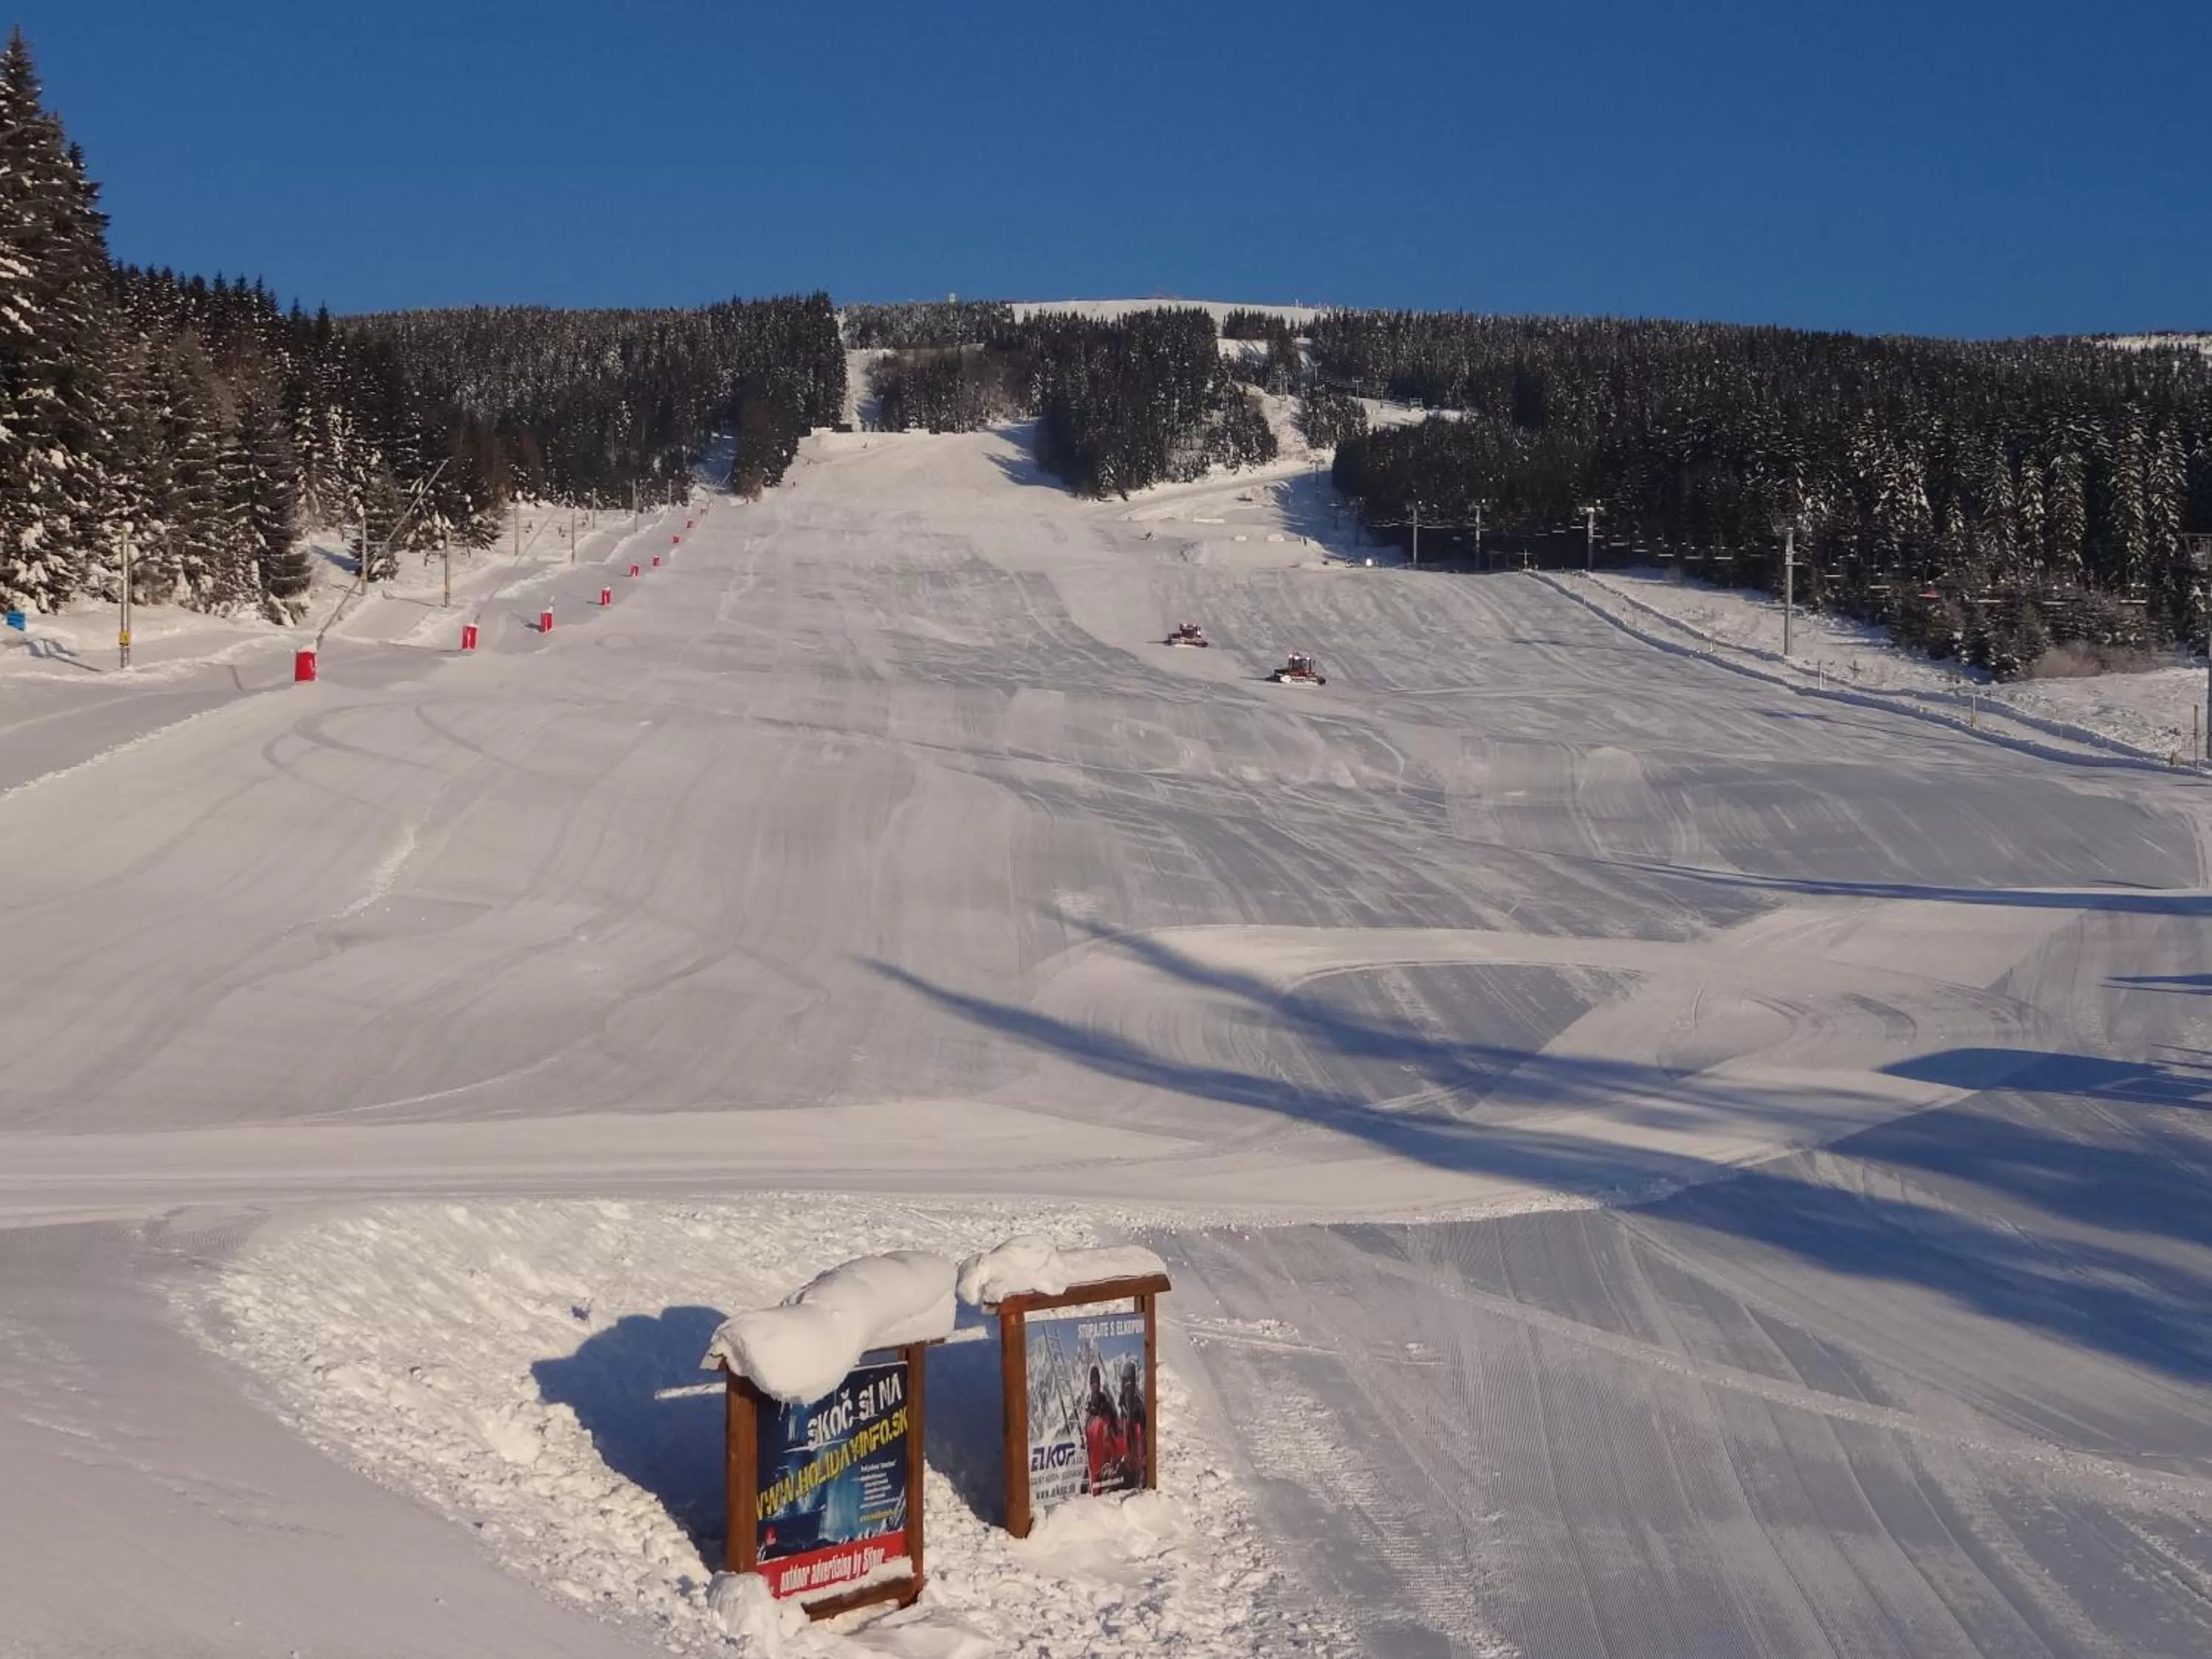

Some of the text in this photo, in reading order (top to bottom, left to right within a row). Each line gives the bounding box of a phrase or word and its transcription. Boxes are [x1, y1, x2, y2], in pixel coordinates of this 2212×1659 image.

[807, 1372, 902, 1452] SKOČ SI NA
